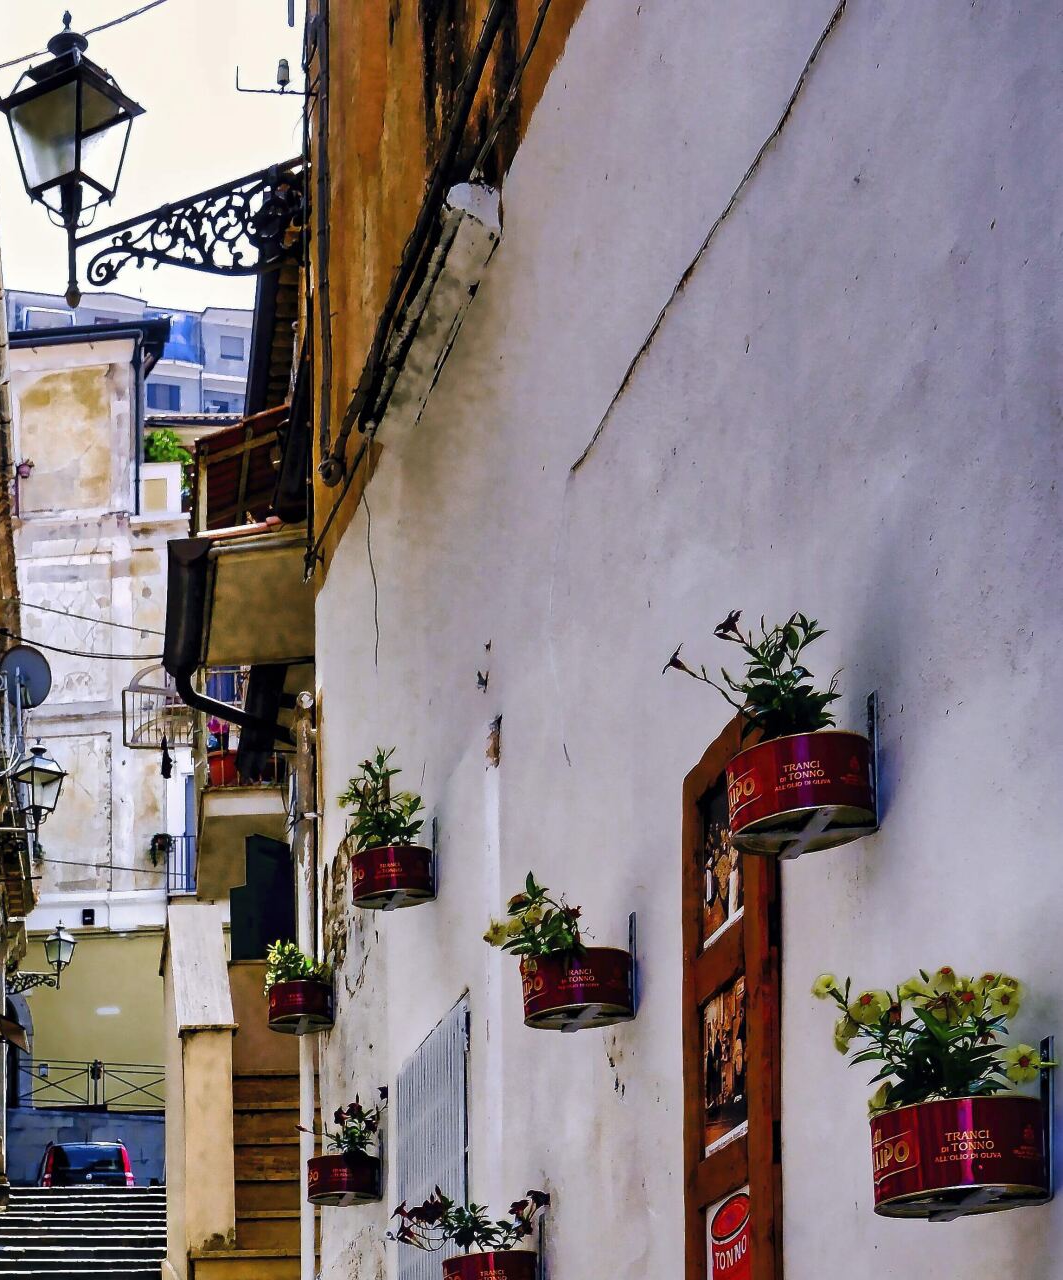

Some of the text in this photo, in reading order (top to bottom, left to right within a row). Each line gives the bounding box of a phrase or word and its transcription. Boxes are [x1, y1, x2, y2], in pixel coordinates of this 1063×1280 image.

[783, 760, 820, 773] TRANCI
[788, 769, 825, 781] TONNO
[945, 1129, 990, 1142] TRANCI
[951, 1140, 995, 1152] TONNO
[715, 1234, 747, 1271] TONNO
